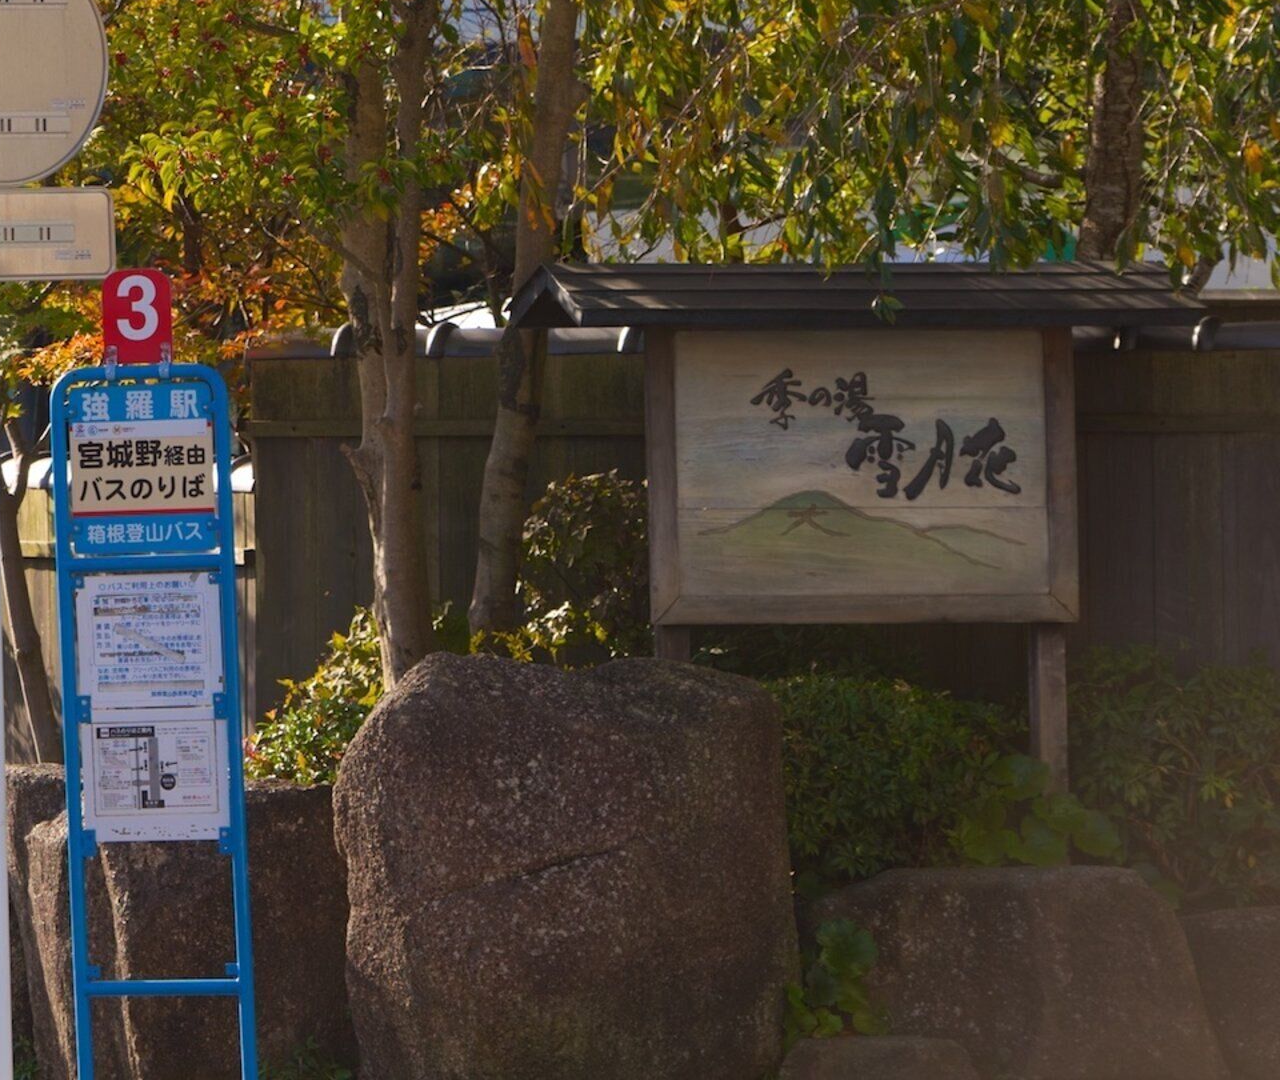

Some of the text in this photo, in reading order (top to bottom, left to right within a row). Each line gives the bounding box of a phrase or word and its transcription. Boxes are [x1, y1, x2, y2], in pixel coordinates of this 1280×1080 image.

[116, 274, 159, 341] 3
[81, 389, 200, 422] 強羅駅
[750, 368, 875, 431] 季の湯
[78, 439, 206, 469] 宮城野経由
[845, 414, 1022, 501] 雪月花
[79, 473, 207, 502] バスのりば
[87, 521, 203, 545] 箱根登山バス
